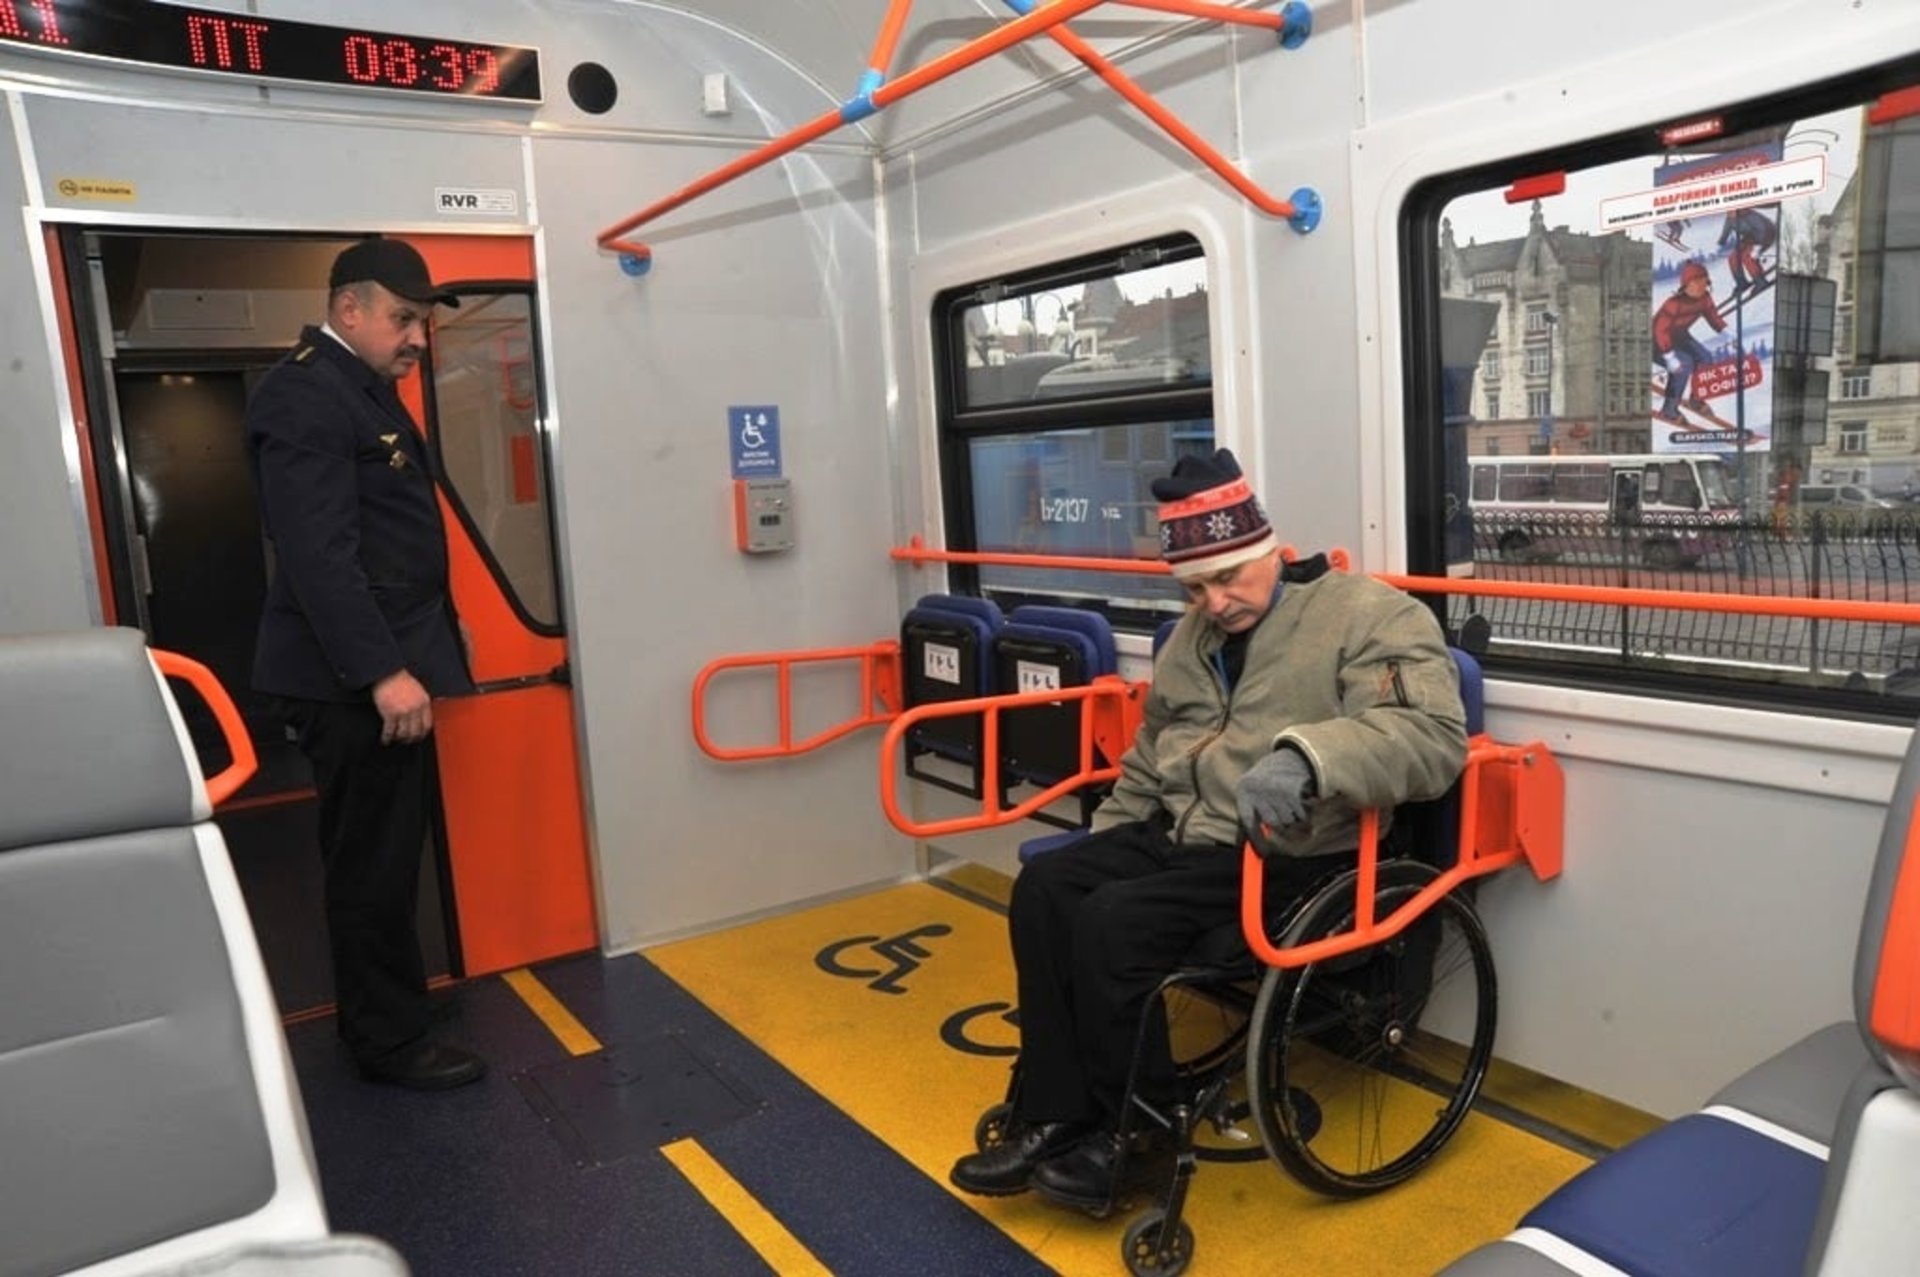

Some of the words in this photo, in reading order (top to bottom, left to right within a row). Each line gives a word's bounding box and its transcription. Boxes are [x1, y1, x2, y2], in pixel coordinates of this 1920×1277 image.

[187, 15, 269, 70] ПТ
[344, 36, 498, 92] 08:39
[1720, 178, 1757, 194] ВИХІД
[441, 194, 477, 208] RVR
[1709, 372, 1757, 394] ОФІІ?
